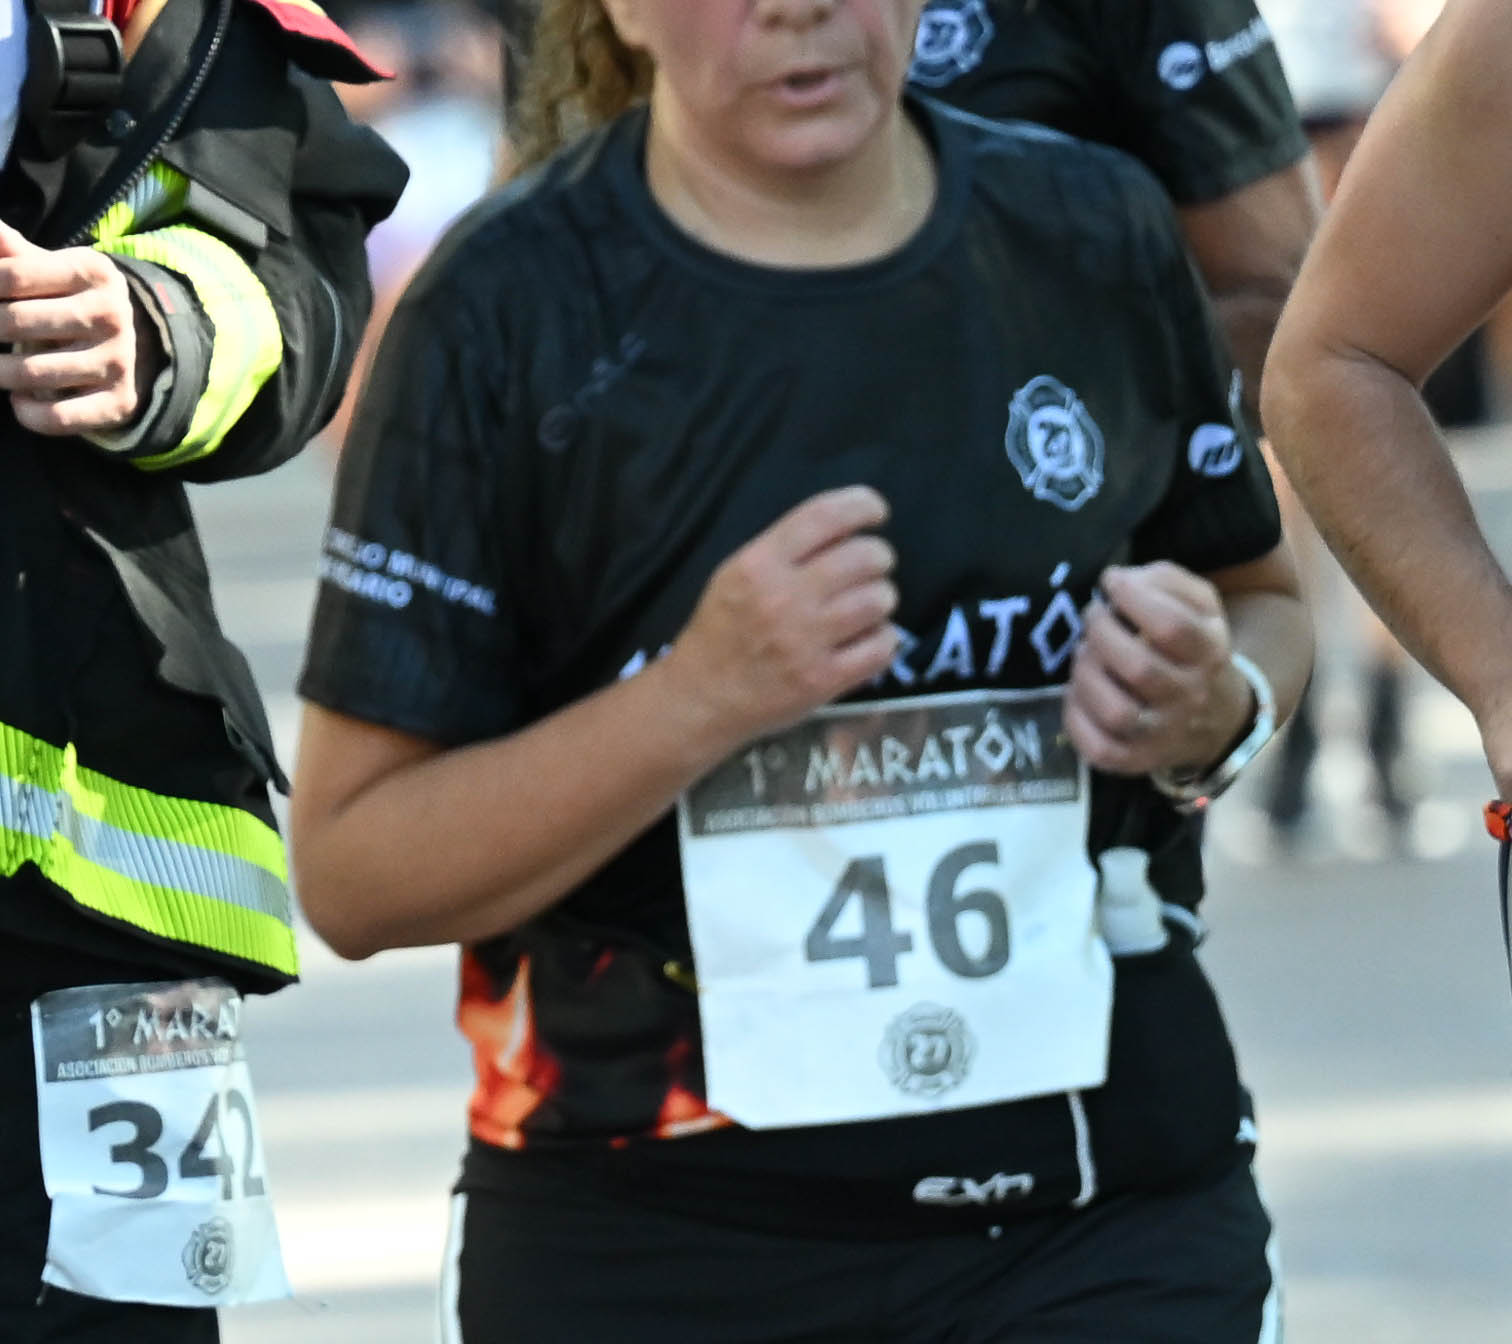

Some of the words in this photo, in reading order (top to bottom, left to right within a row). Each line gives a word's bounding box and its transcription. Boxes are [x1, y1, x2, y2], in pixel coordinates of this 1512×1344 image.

[872, 562, 1084, 685] RATÓ
[804, 707, 1043, 794] MARATÓN
[804, 837, 1012, 990] 46
[87, 1088, 266, 1202] 342
